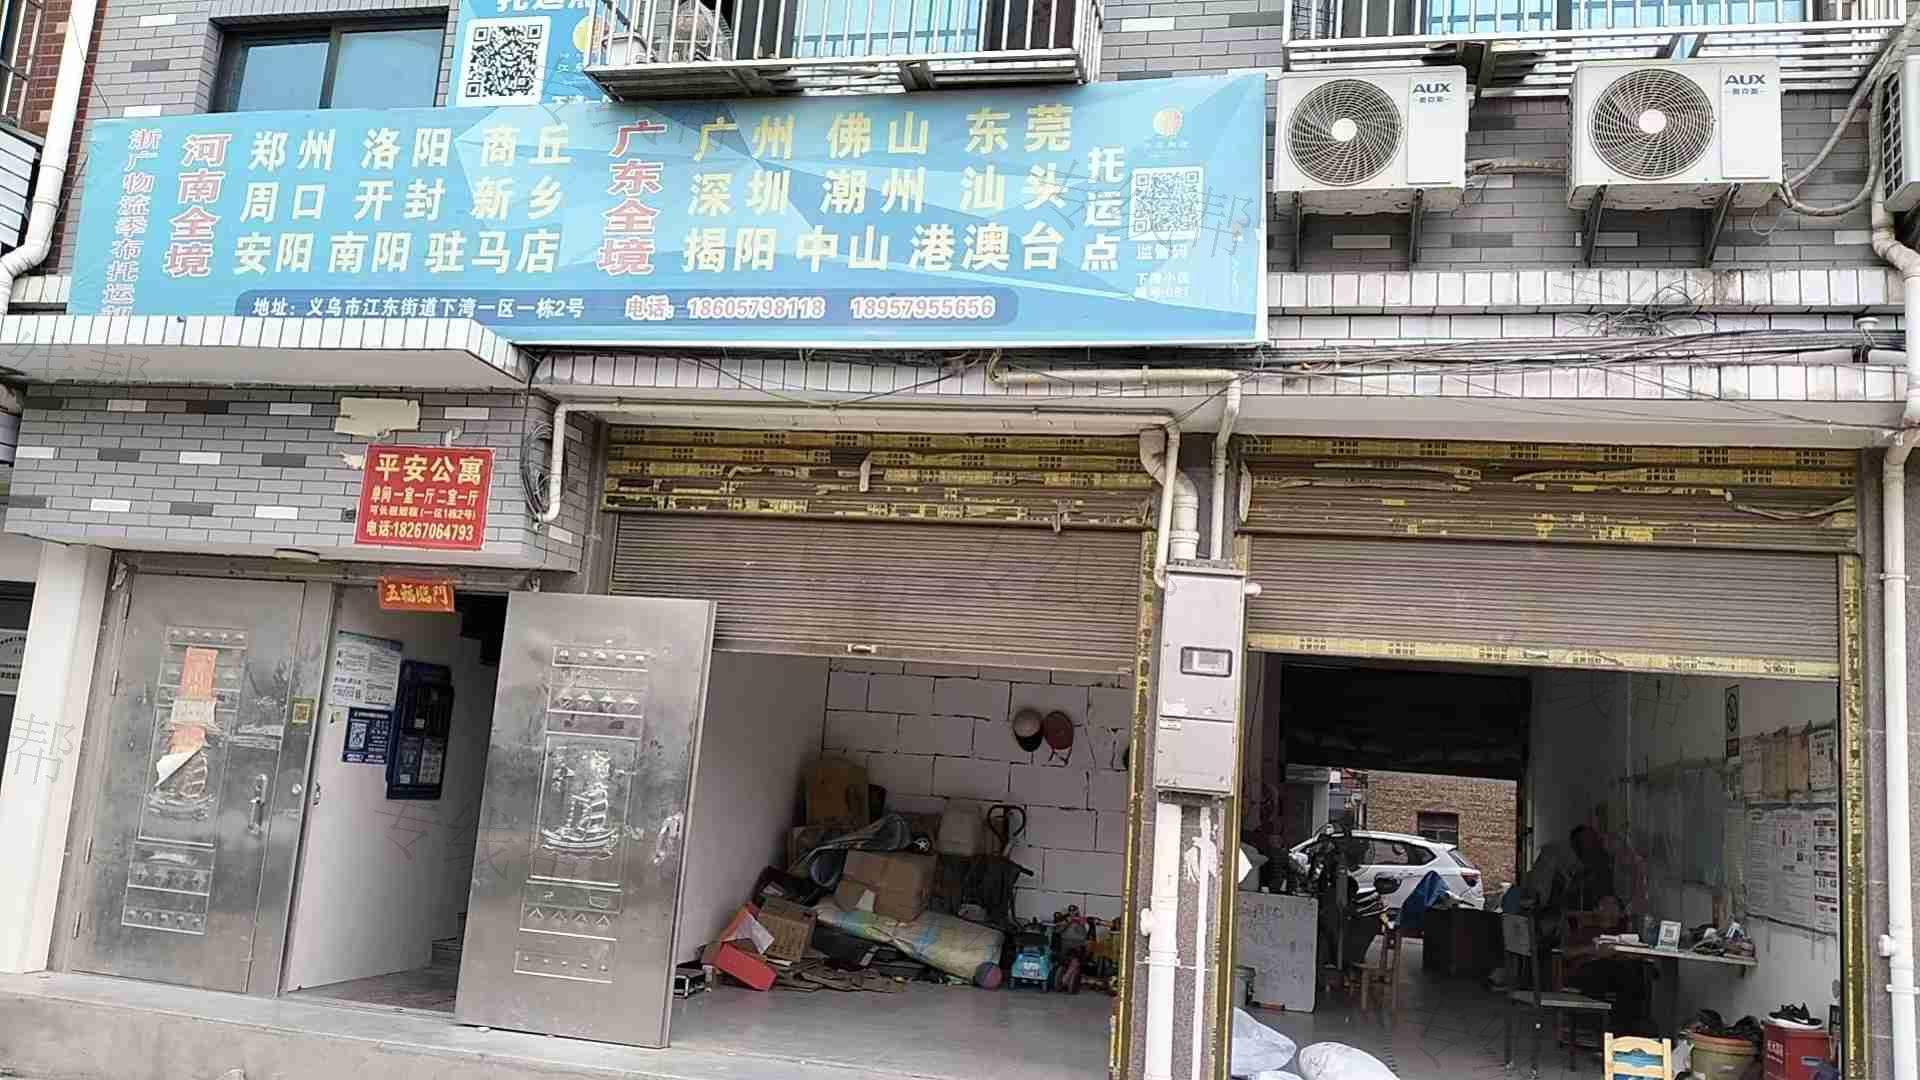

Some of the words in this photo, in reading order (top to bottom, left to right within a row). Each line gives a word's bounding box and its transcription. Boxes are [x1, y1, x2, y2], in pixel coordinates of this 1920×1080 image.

[1412, 82, 1452, 94] AUX
[1725, 74, 1766, 86] AUX
[249, 128, 336, 171] 郑州
[361, 127, 452, 169] 洛阳
[480, 123, 572, 168] 商丘
[694, 116, 795, 161] 广州
[827, 111, 929, 158] 佛山
[965, 104, 1073, 153] 东莞
[163, 133, 232, 277] 河南全境
[240, 181, 326, 223] 周口
[354, 178, 447, 221] 开封
[471, 176, 564, 220] 新乡
[597, 121, 667, 276] 广东全境
[688, 171, 790, 217] 深圳
[820, 167, 925, 215] 潮州
[960, 163, 1069, 212] 汕头
[1081, 144, 1125, 272] 托运点
[234, 231, 314, 274] 安阳
[328, 231, 412, 274] 南阳
[426, 229, 560, 274] 驻马店
[682, 227, 777, 274] 揭阳
[795, 225, 890, 273] 中山
[909, 220, 1064, 273] 港澳台
[687, 295, 824, 320] 18605798118
[851, 295, 995, 319] 18957955656
[375, 453, 484, 485] 平安公寓
